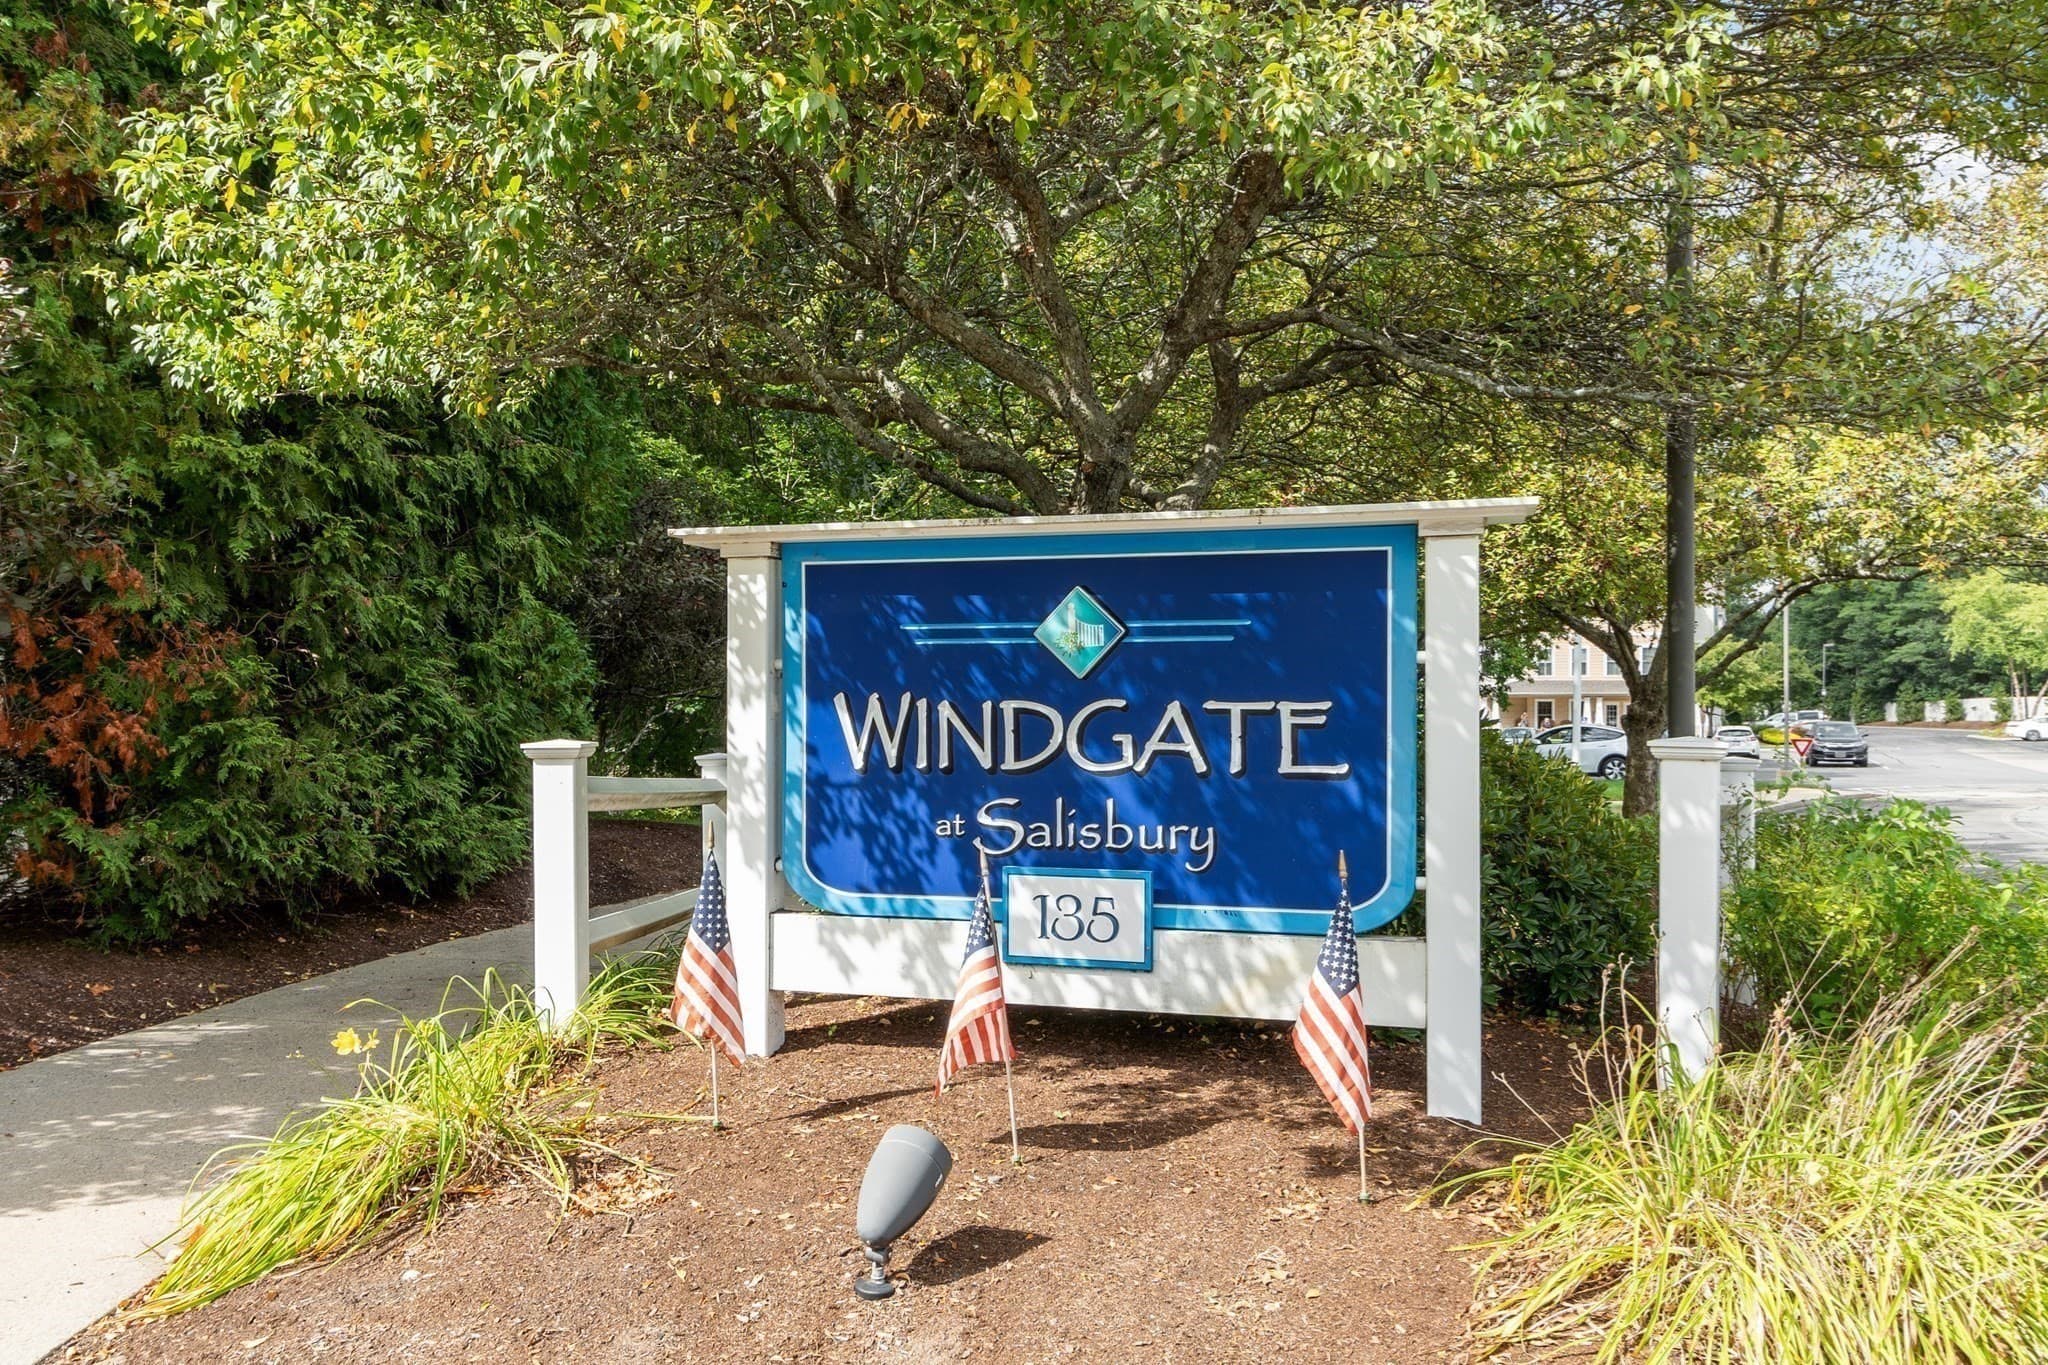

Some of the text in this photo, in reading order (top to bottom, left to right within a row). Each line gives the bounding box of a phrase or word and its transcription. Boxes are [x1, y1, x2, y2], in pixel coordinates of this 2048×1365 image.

[833, 690, 1350, 776] WINDGATE
[935, 796, 1214, 872] at Salisbury
[1032, 893, 1120, 943] 135
